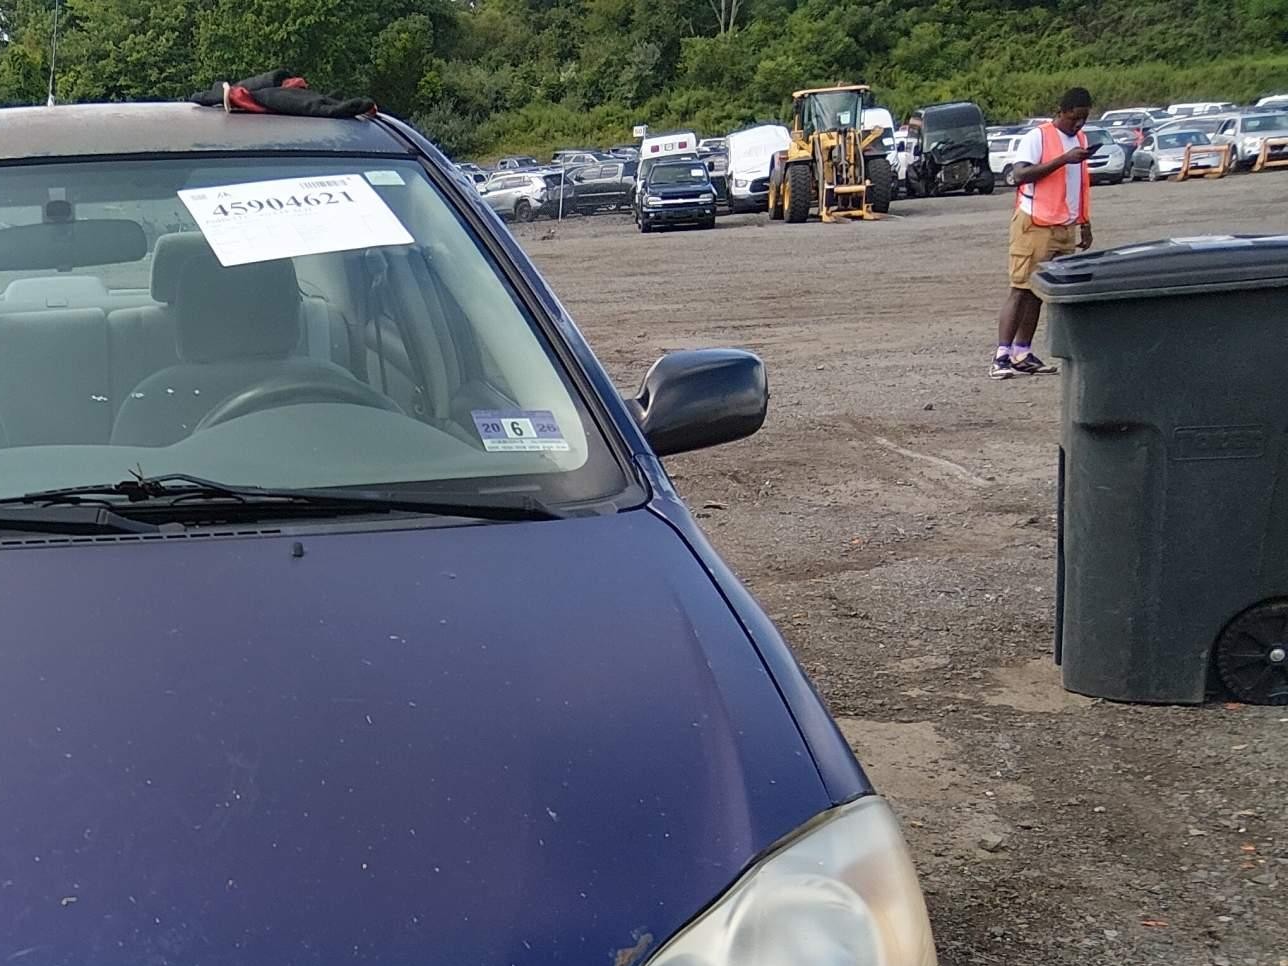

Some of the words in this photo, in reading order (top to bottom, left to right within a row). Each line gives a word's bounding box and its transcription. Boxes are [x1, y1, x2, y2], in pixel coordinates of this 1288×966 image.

[213, 190, 354, 217] 45904621
[481, 422, 501, 433] 20
[510, 421, 524, 437] 6
